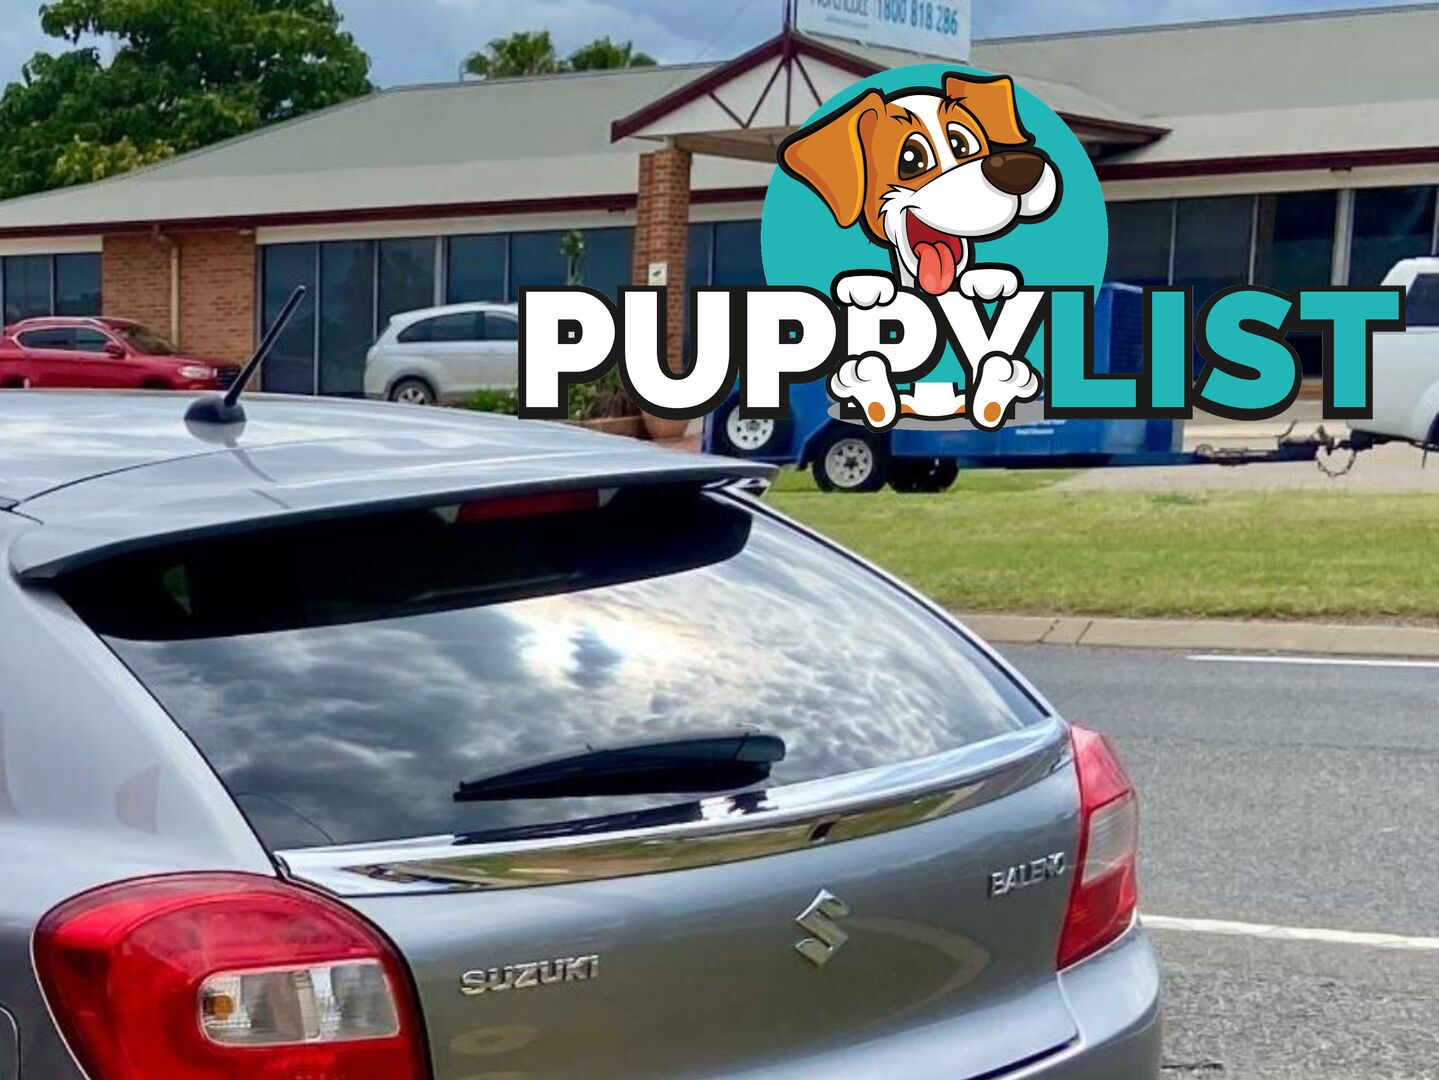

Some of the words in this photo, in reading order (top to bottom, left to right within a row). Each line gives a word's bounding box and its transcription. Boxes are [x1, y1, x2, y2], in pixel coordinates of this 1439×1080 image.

[877, 0, 907, 24] 1800
[911, 0, 933, 29] 818
[936, 5, 958, 36] 286
[990, 851, 1065, 897] BALENO
[461, 954, 600, 996] SUZUKI
